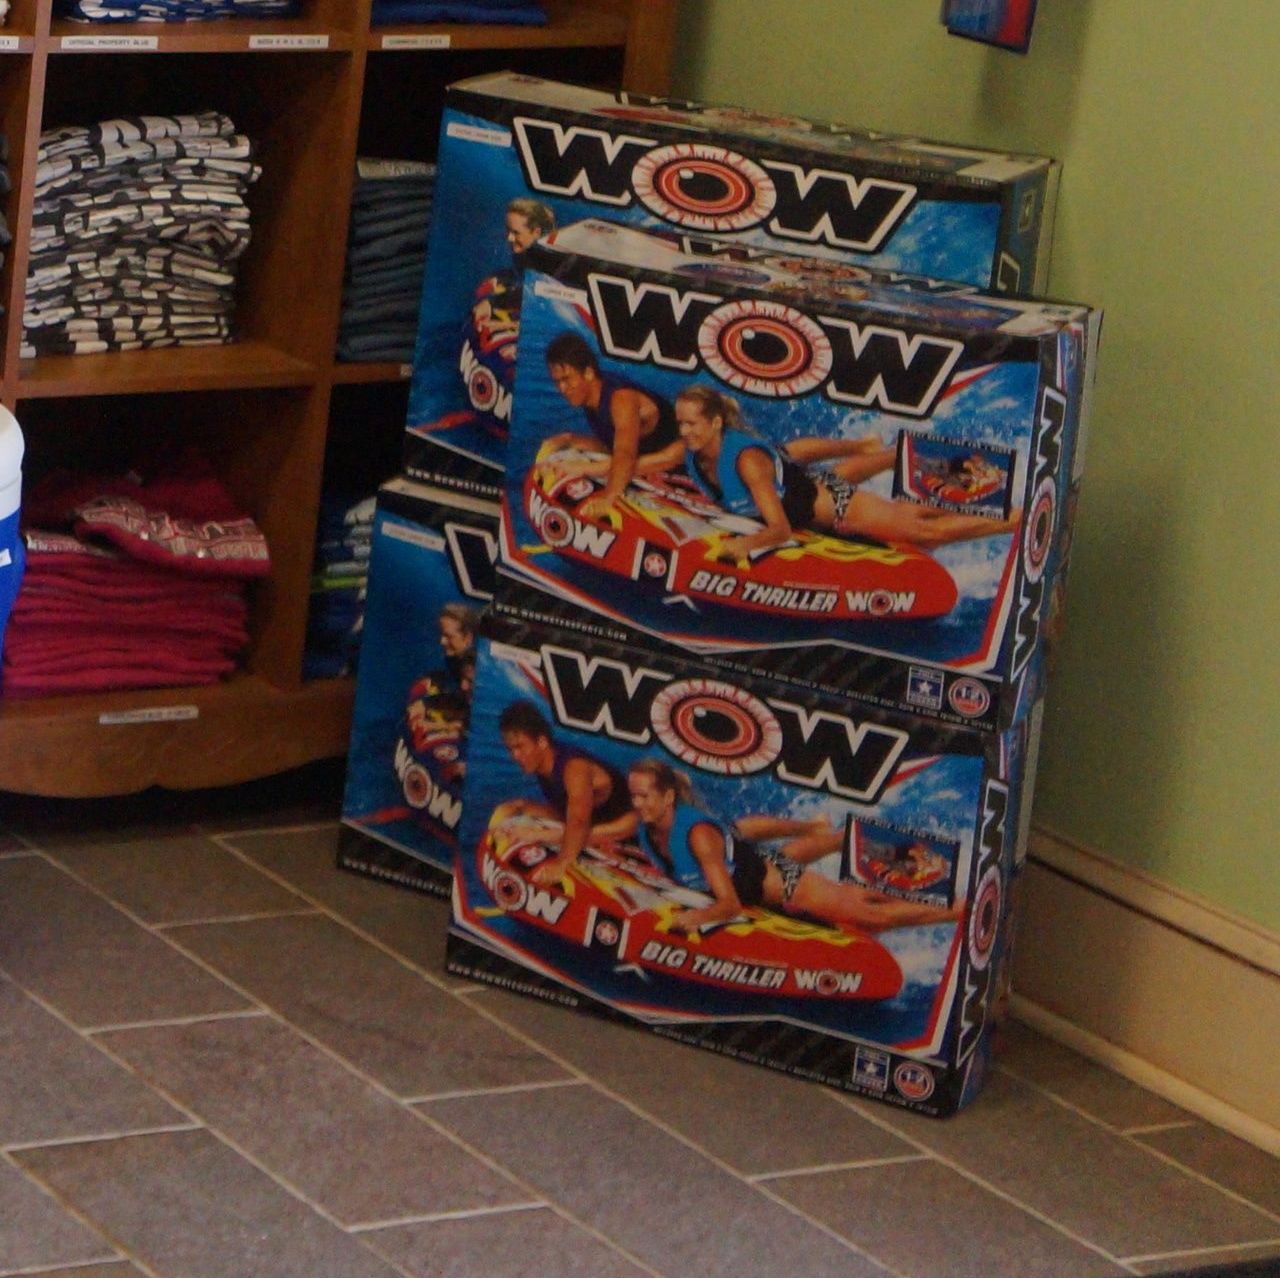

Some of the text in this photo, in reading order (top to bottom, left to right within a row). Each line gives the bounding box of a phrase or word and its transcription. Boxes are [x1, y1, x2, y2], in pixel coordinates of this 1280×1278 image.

[513, 116, 917, 252] WOW
[587, 272, 963, 417] WOW
[688, 570, 917, 617] BIG THRILLER WOW
[541, 644, 910, 805] WOW
[640, 940, 862, 997] BIG THRILLER WOW
